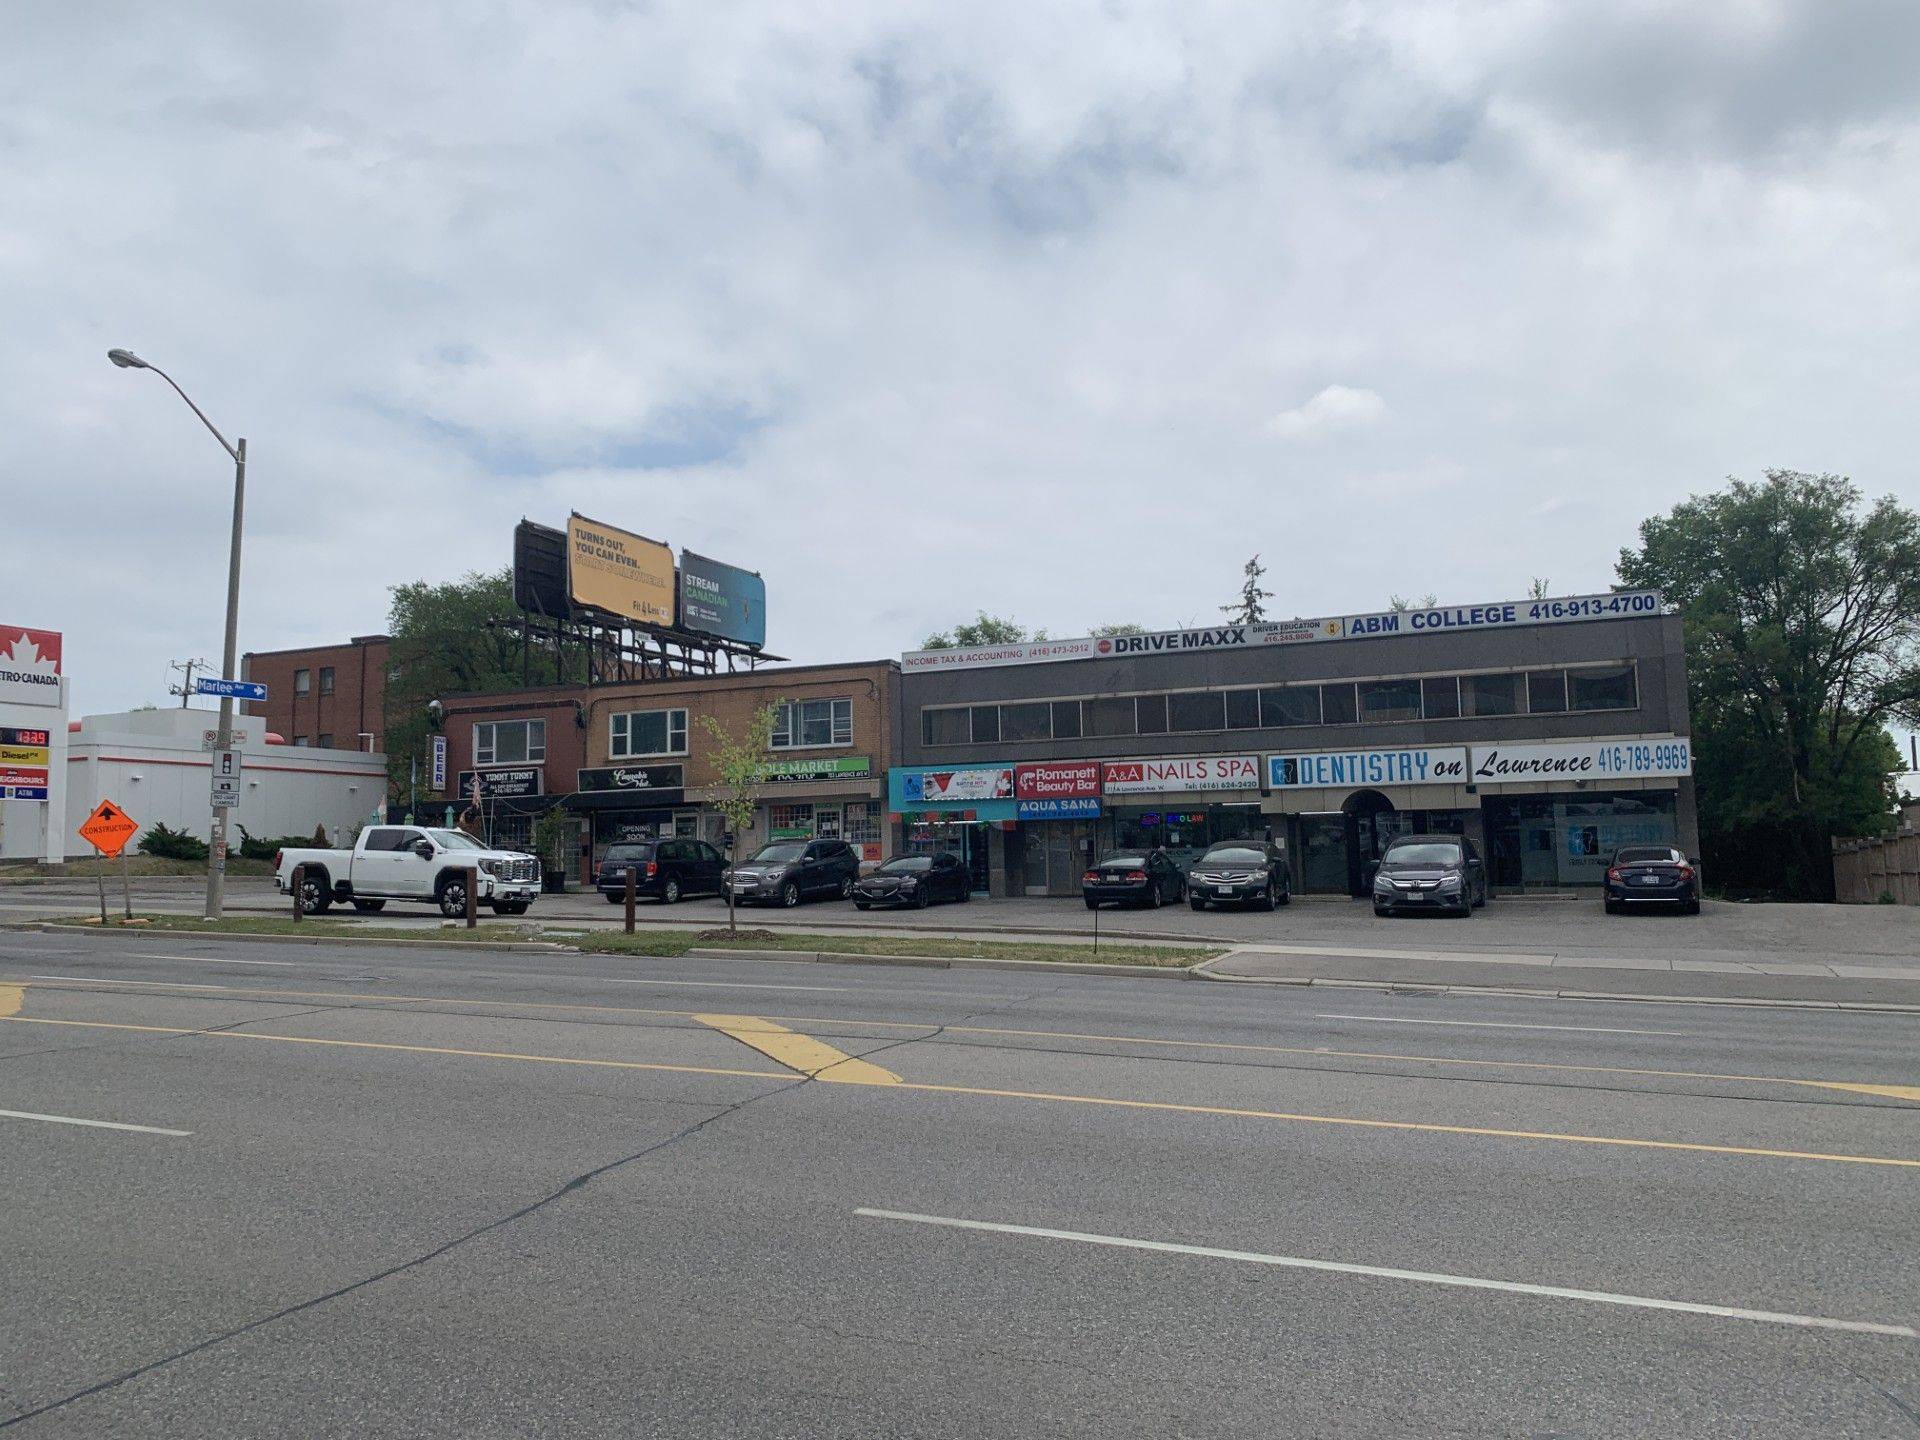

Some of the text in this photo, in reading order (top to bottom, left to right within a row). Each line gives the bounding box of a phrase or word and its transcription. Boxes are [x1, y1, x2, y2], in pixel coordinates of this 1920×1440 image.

[575, 528, 626, 554] TURNS OUT,
[575, 541, 641, 569] YOU CAN EVEN.
[686, 574, 719, 592] STREAM
[687, 587, 728, 608] CANADIAN
[1351, 595, 1656, 635] ABM COLLEGE 416-913-4700
[1252, 625, 1278, 633] DRIVER
[1115, 629, 1247, 653] DRIVE MAXX
[905, 657, 938, 666] INCOME
[941, 656, 956, 664] TAX
[965, 651, 1023, 662] ACCOUNTING
[1029, 648, 1050, 659] (416)
[1051, 644, 1090, 655] 473-2912
[198, 680, 234, 693] Marlee
[2, 751, 29, 760] Diesel
[436, 744, 444, 782] BEER
[1475, 743, 1689, 777] Lawrence 416-789-9969
[789, 760, 839, 774] MARKET
[1036, 768, 1096, 780] Romanett
[1106, 759, 1256, 781] A&A NAILS SPA
[1300, 751, 1465, 785] DENTISTRY on
[510, 771, 534, 780] TUMMY
[17, 789, 33, 797] ATM
[1036, 780, 1096, 793] Beauty Bar
[1199, 781, 1219, 790] (416)
[1221, 780, 1257, 789] 624-2420
[1020, 799, 1098, 812] AQUA SANA
[84, 824, 133, 835] CONSTRUCTION
